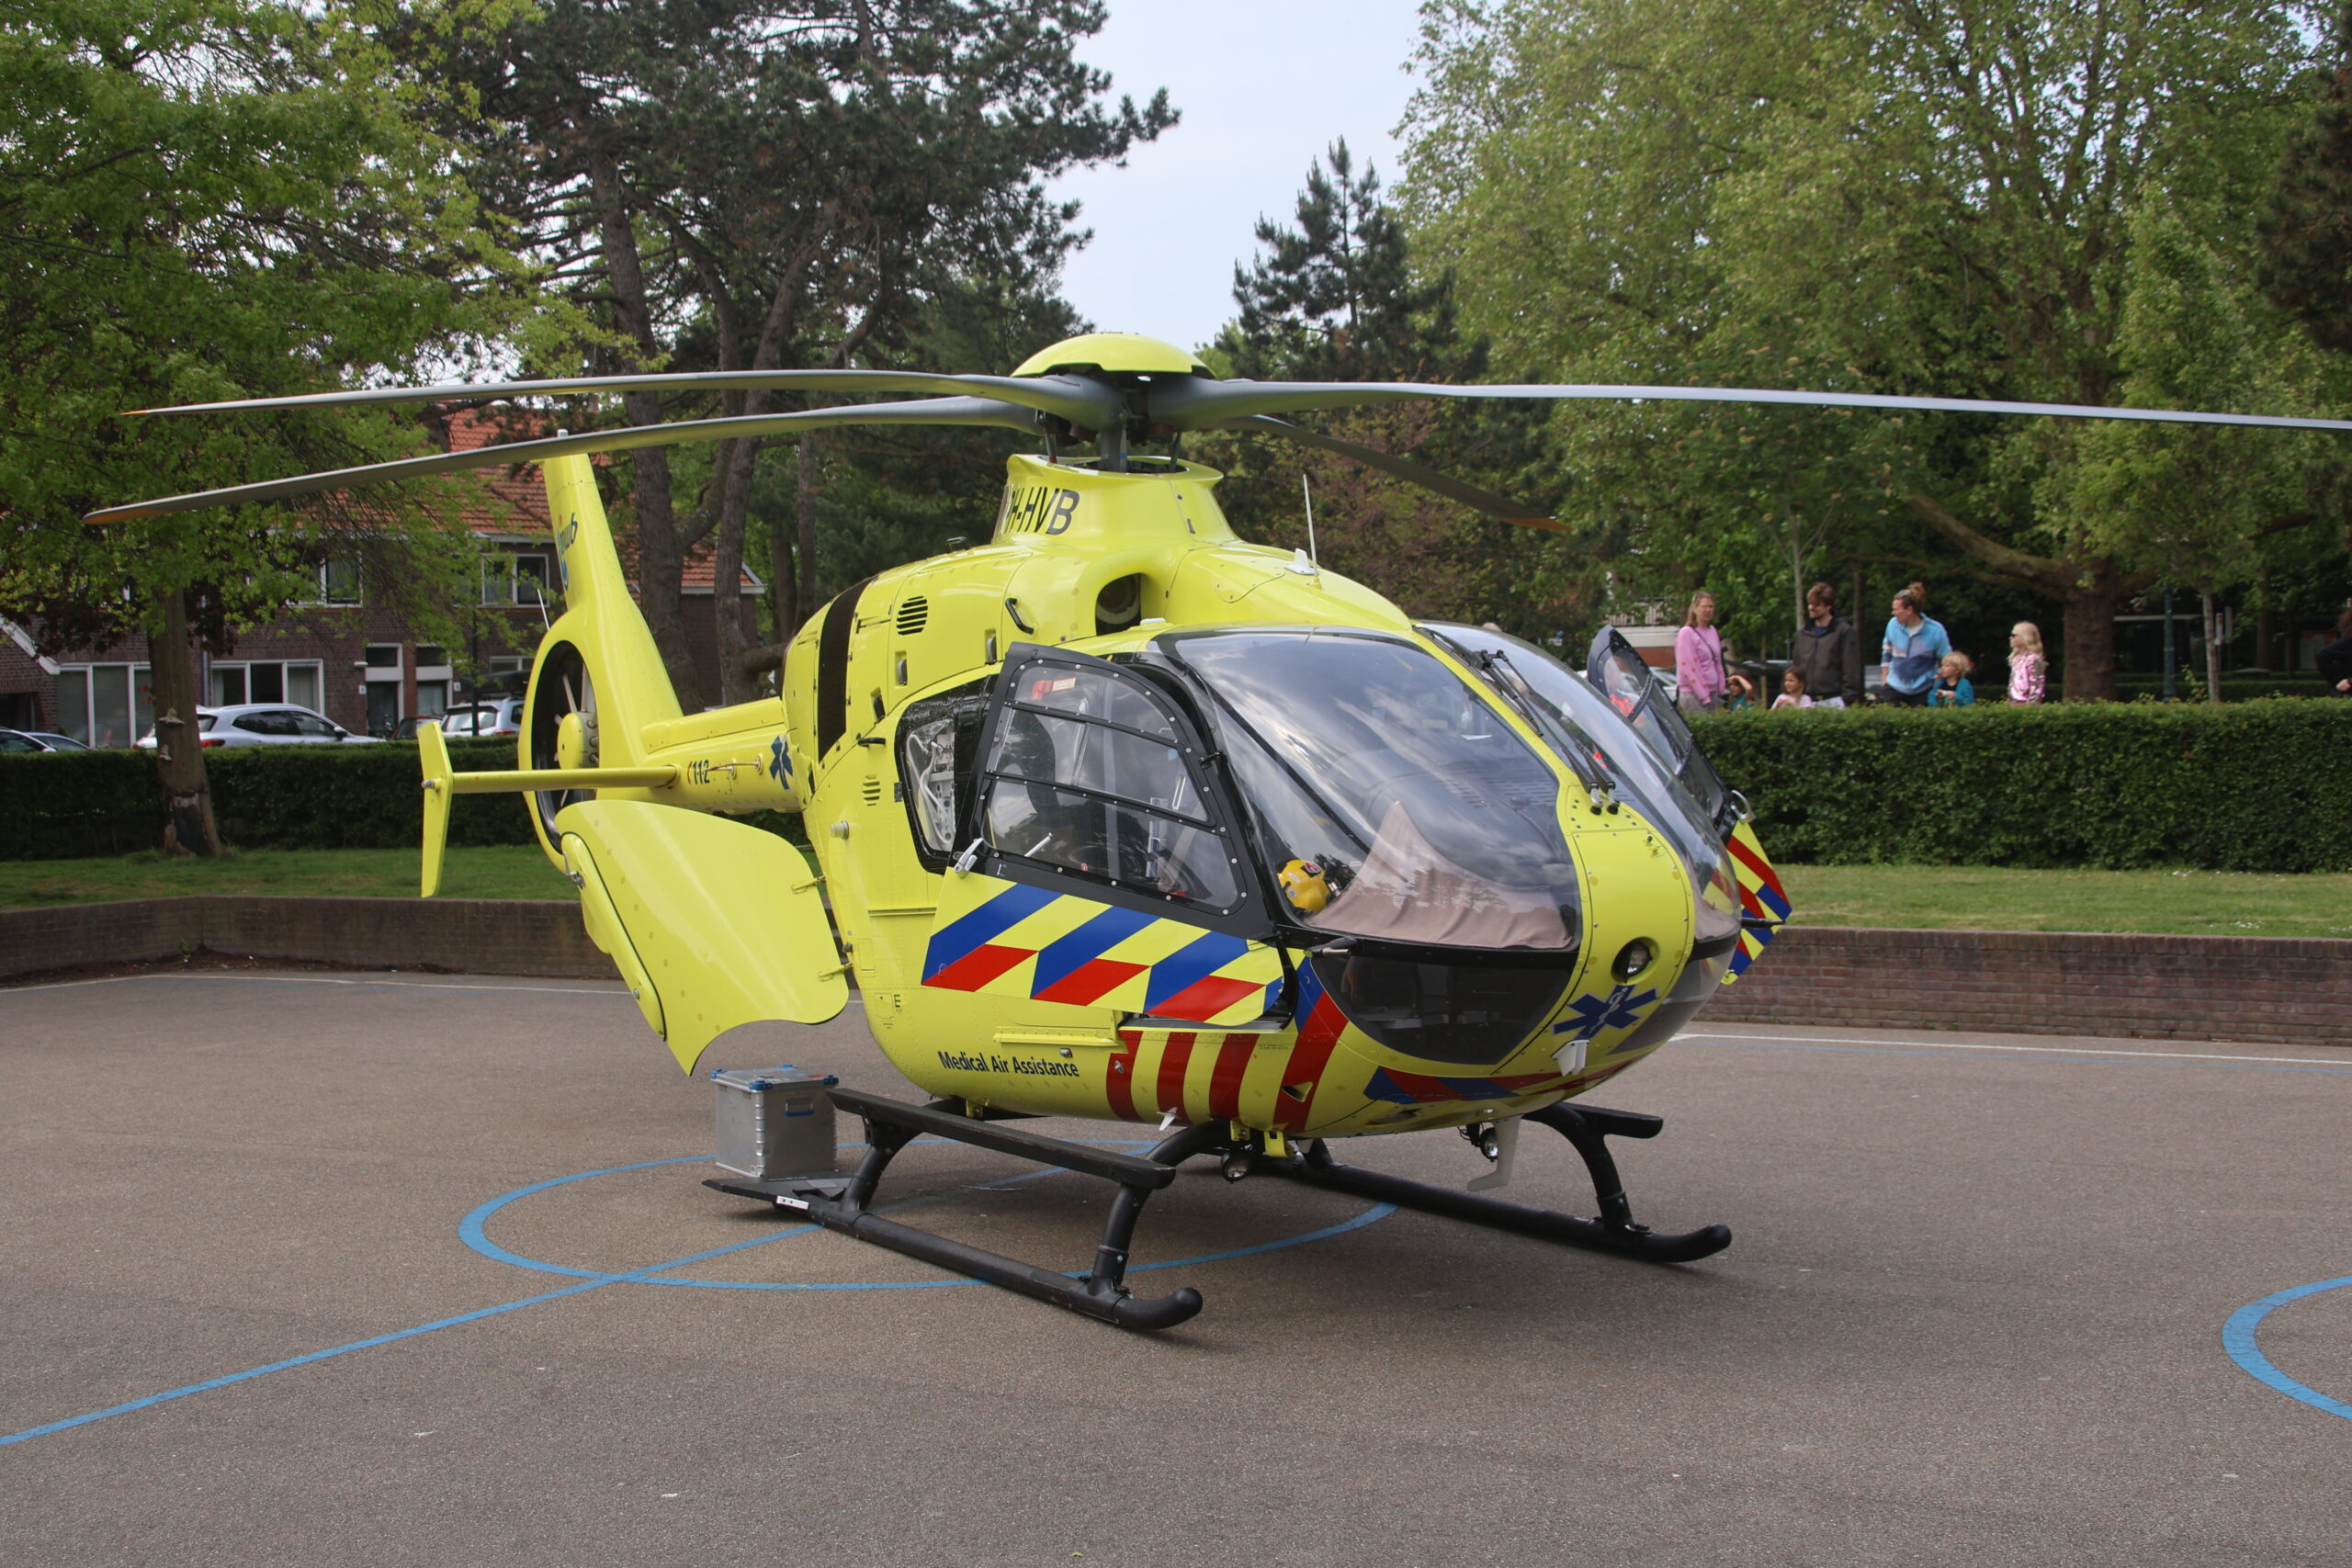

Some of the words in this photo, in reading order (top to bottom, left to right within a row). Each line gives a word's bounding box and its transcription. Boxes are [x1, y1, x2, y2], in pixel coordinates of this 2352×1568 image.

[894, 994, 901, 1008] E
[937, 1051, 989, 1072] Medical
[990, 1055, 1010, 1073] Air
[1012, 1056, 1080, 1077] Assistance
